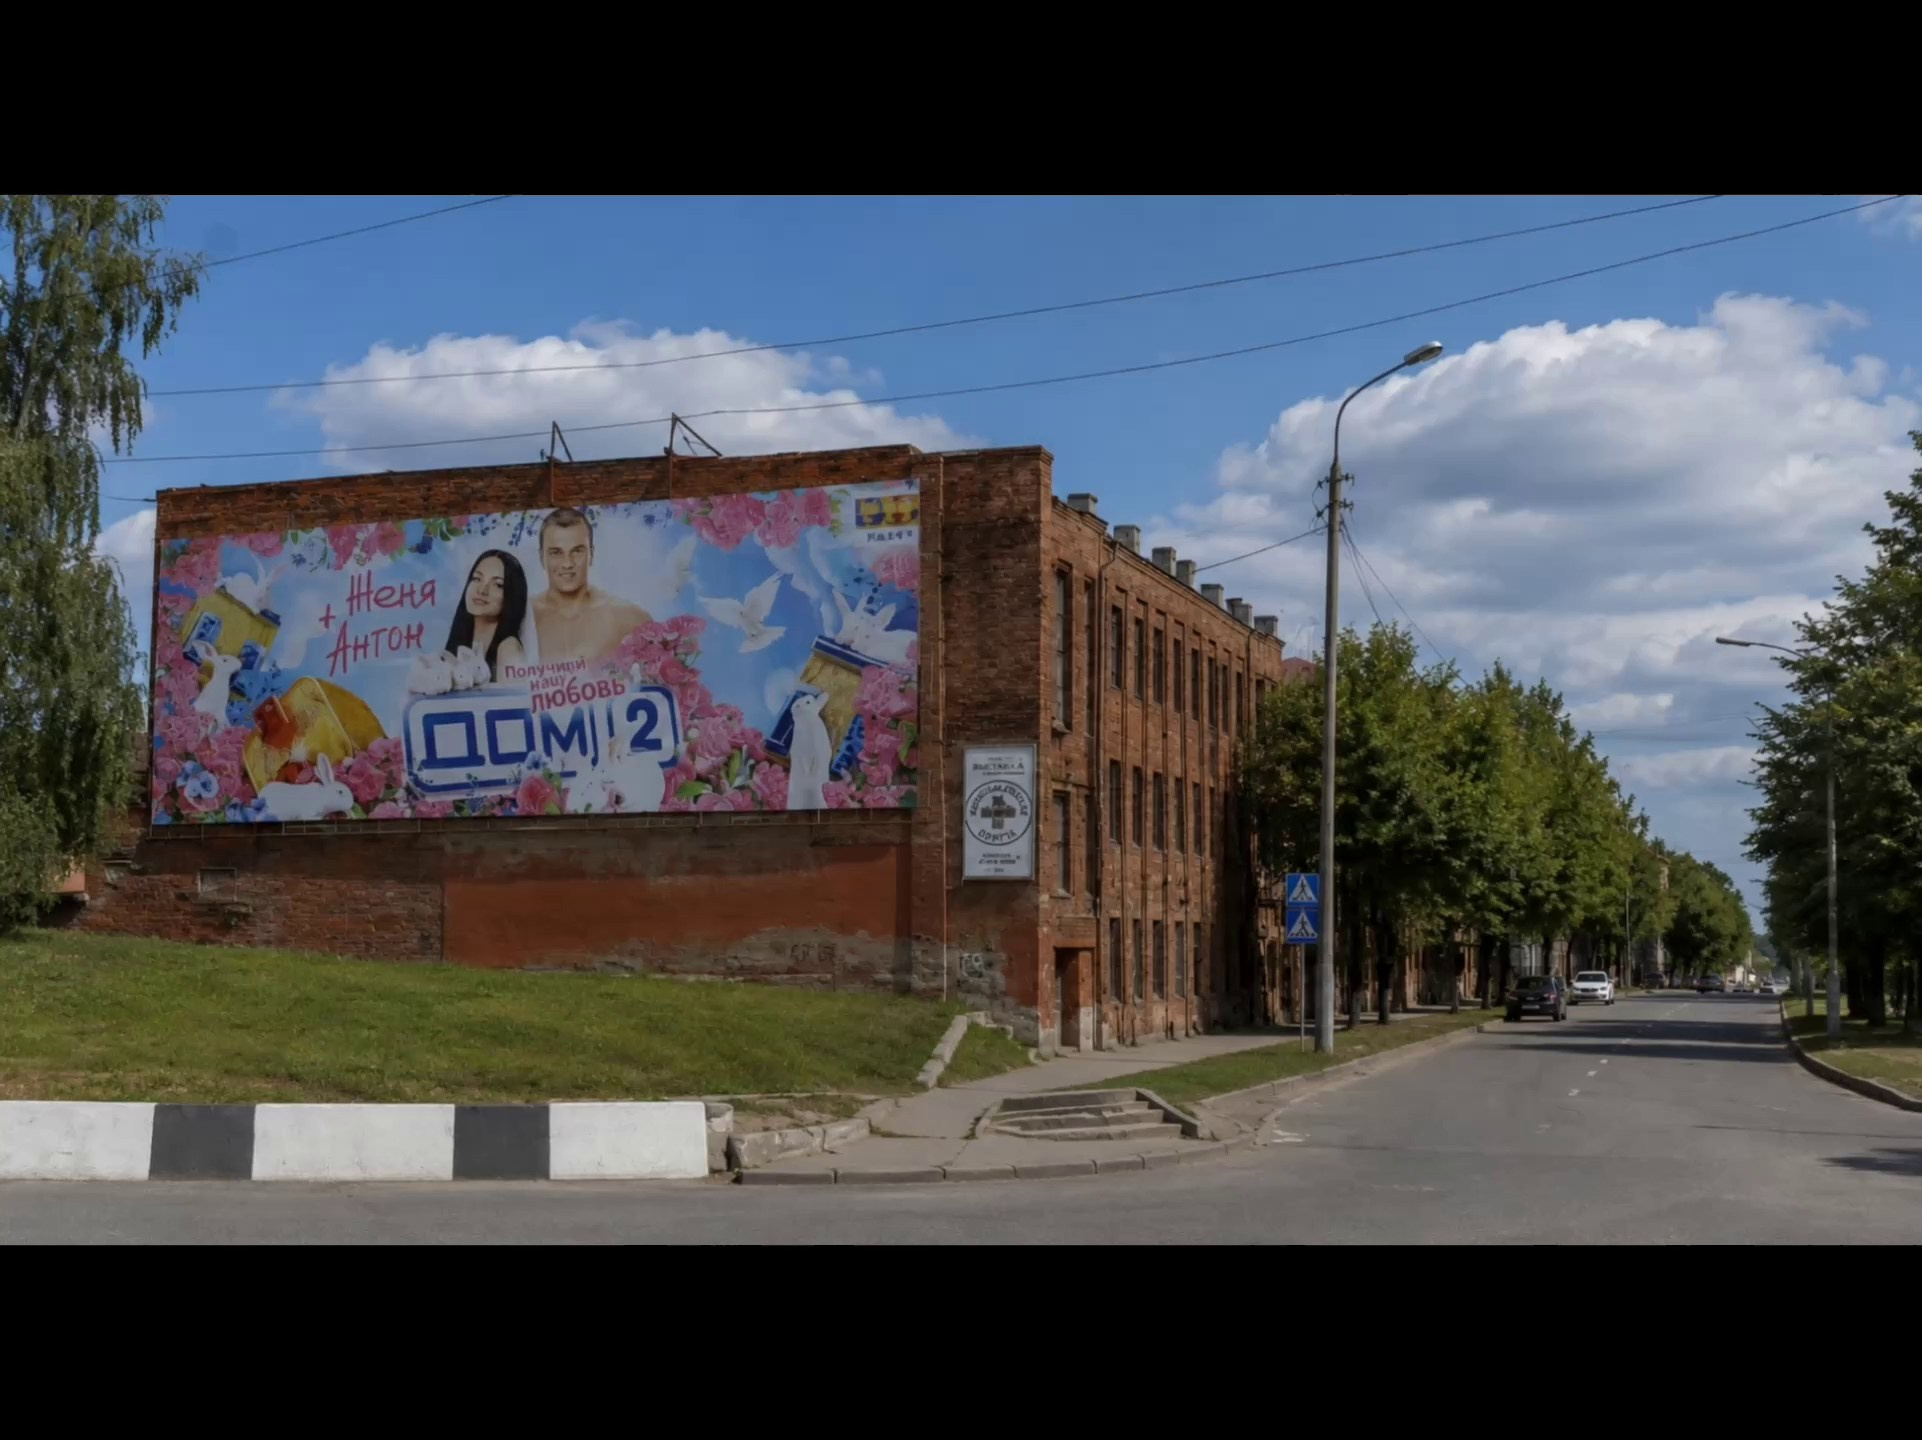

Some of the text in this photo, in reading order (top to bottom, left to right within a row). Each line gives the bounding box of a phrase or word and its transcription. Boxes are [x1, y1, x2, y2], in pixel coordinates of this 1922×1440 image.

[346, 569, 436, 616] Женя
[326, 619, 424, 677] Антон
[626, 697, 663, 752] 2
